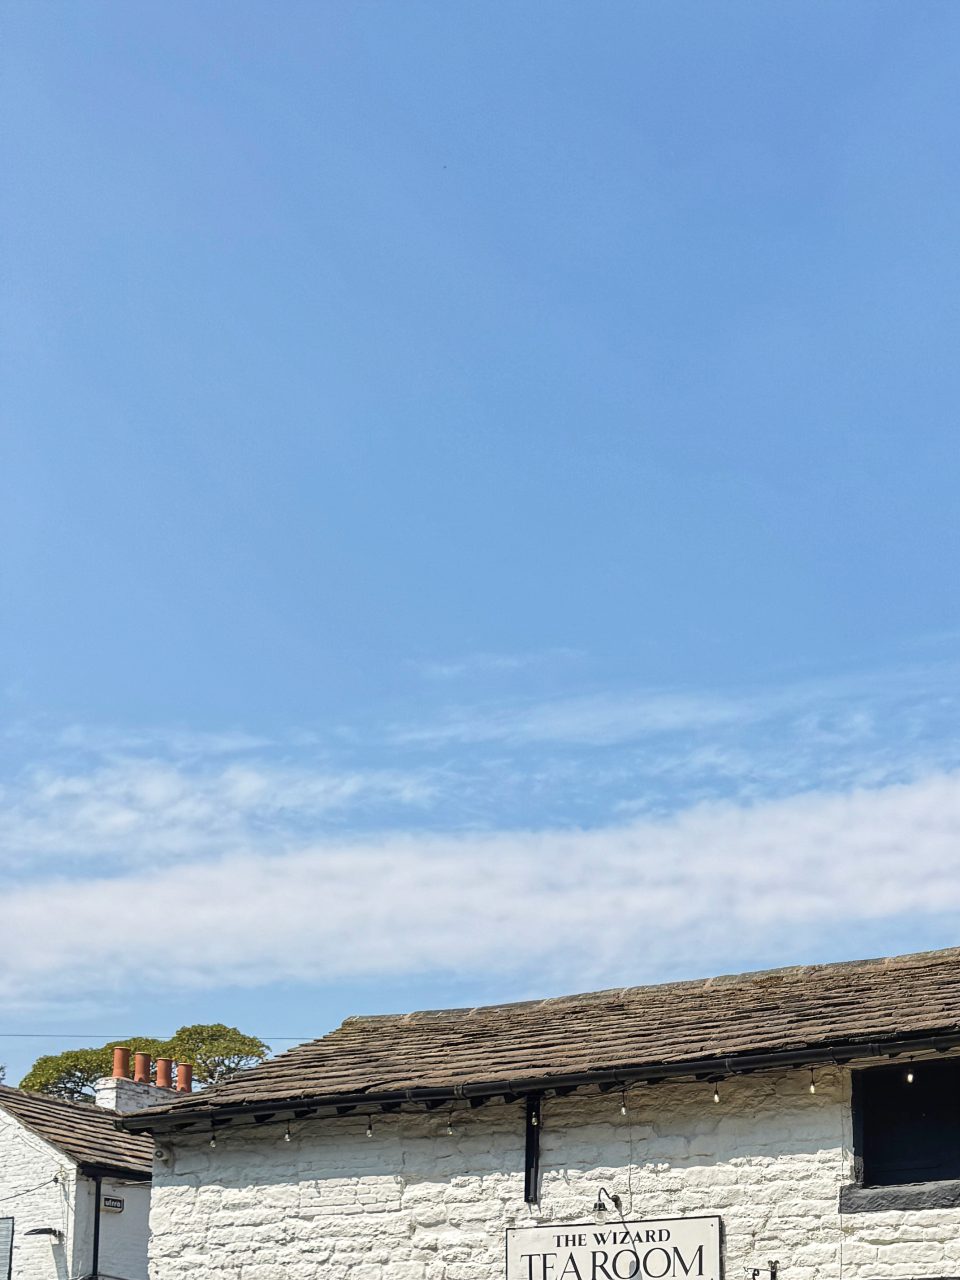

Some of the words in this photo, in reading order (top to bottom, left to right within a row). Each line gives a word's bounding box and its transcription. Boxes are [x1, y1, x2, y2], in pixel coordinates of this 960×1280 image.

[553, 1234, 587, 1248] THE
[593, 1229, 671, 1246] WIZARD
[590, 1245, 705, 1280] ROOM
